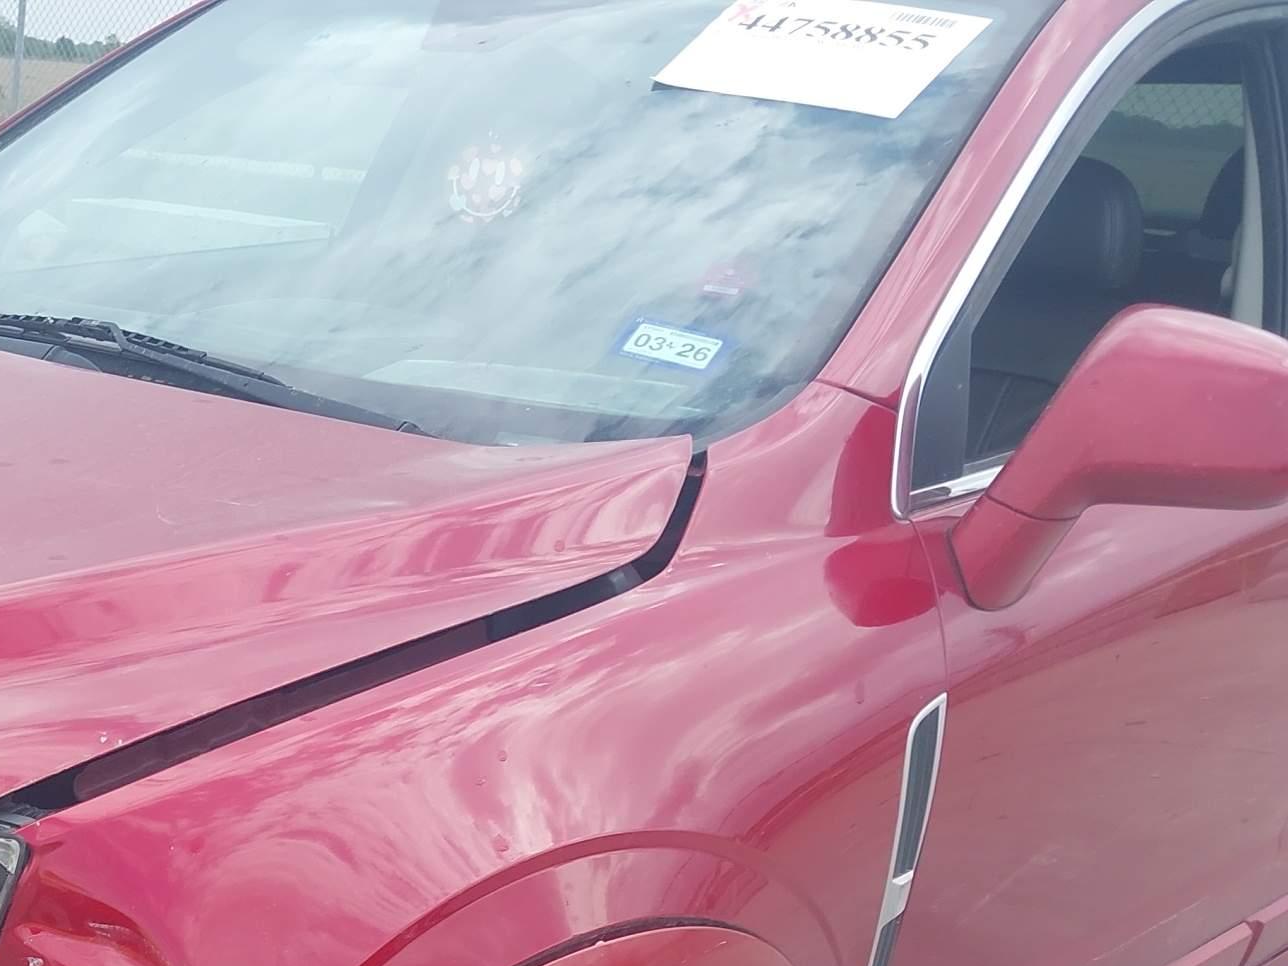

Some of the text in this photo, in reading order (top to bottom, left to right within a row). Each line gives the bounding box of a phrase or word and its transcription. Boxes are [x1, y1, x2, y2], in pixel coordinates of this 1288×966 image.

[737, 13, 937, 50] 44758855
[633, 333, 667, 351] 03
[675, 343, 711, 361] 26
